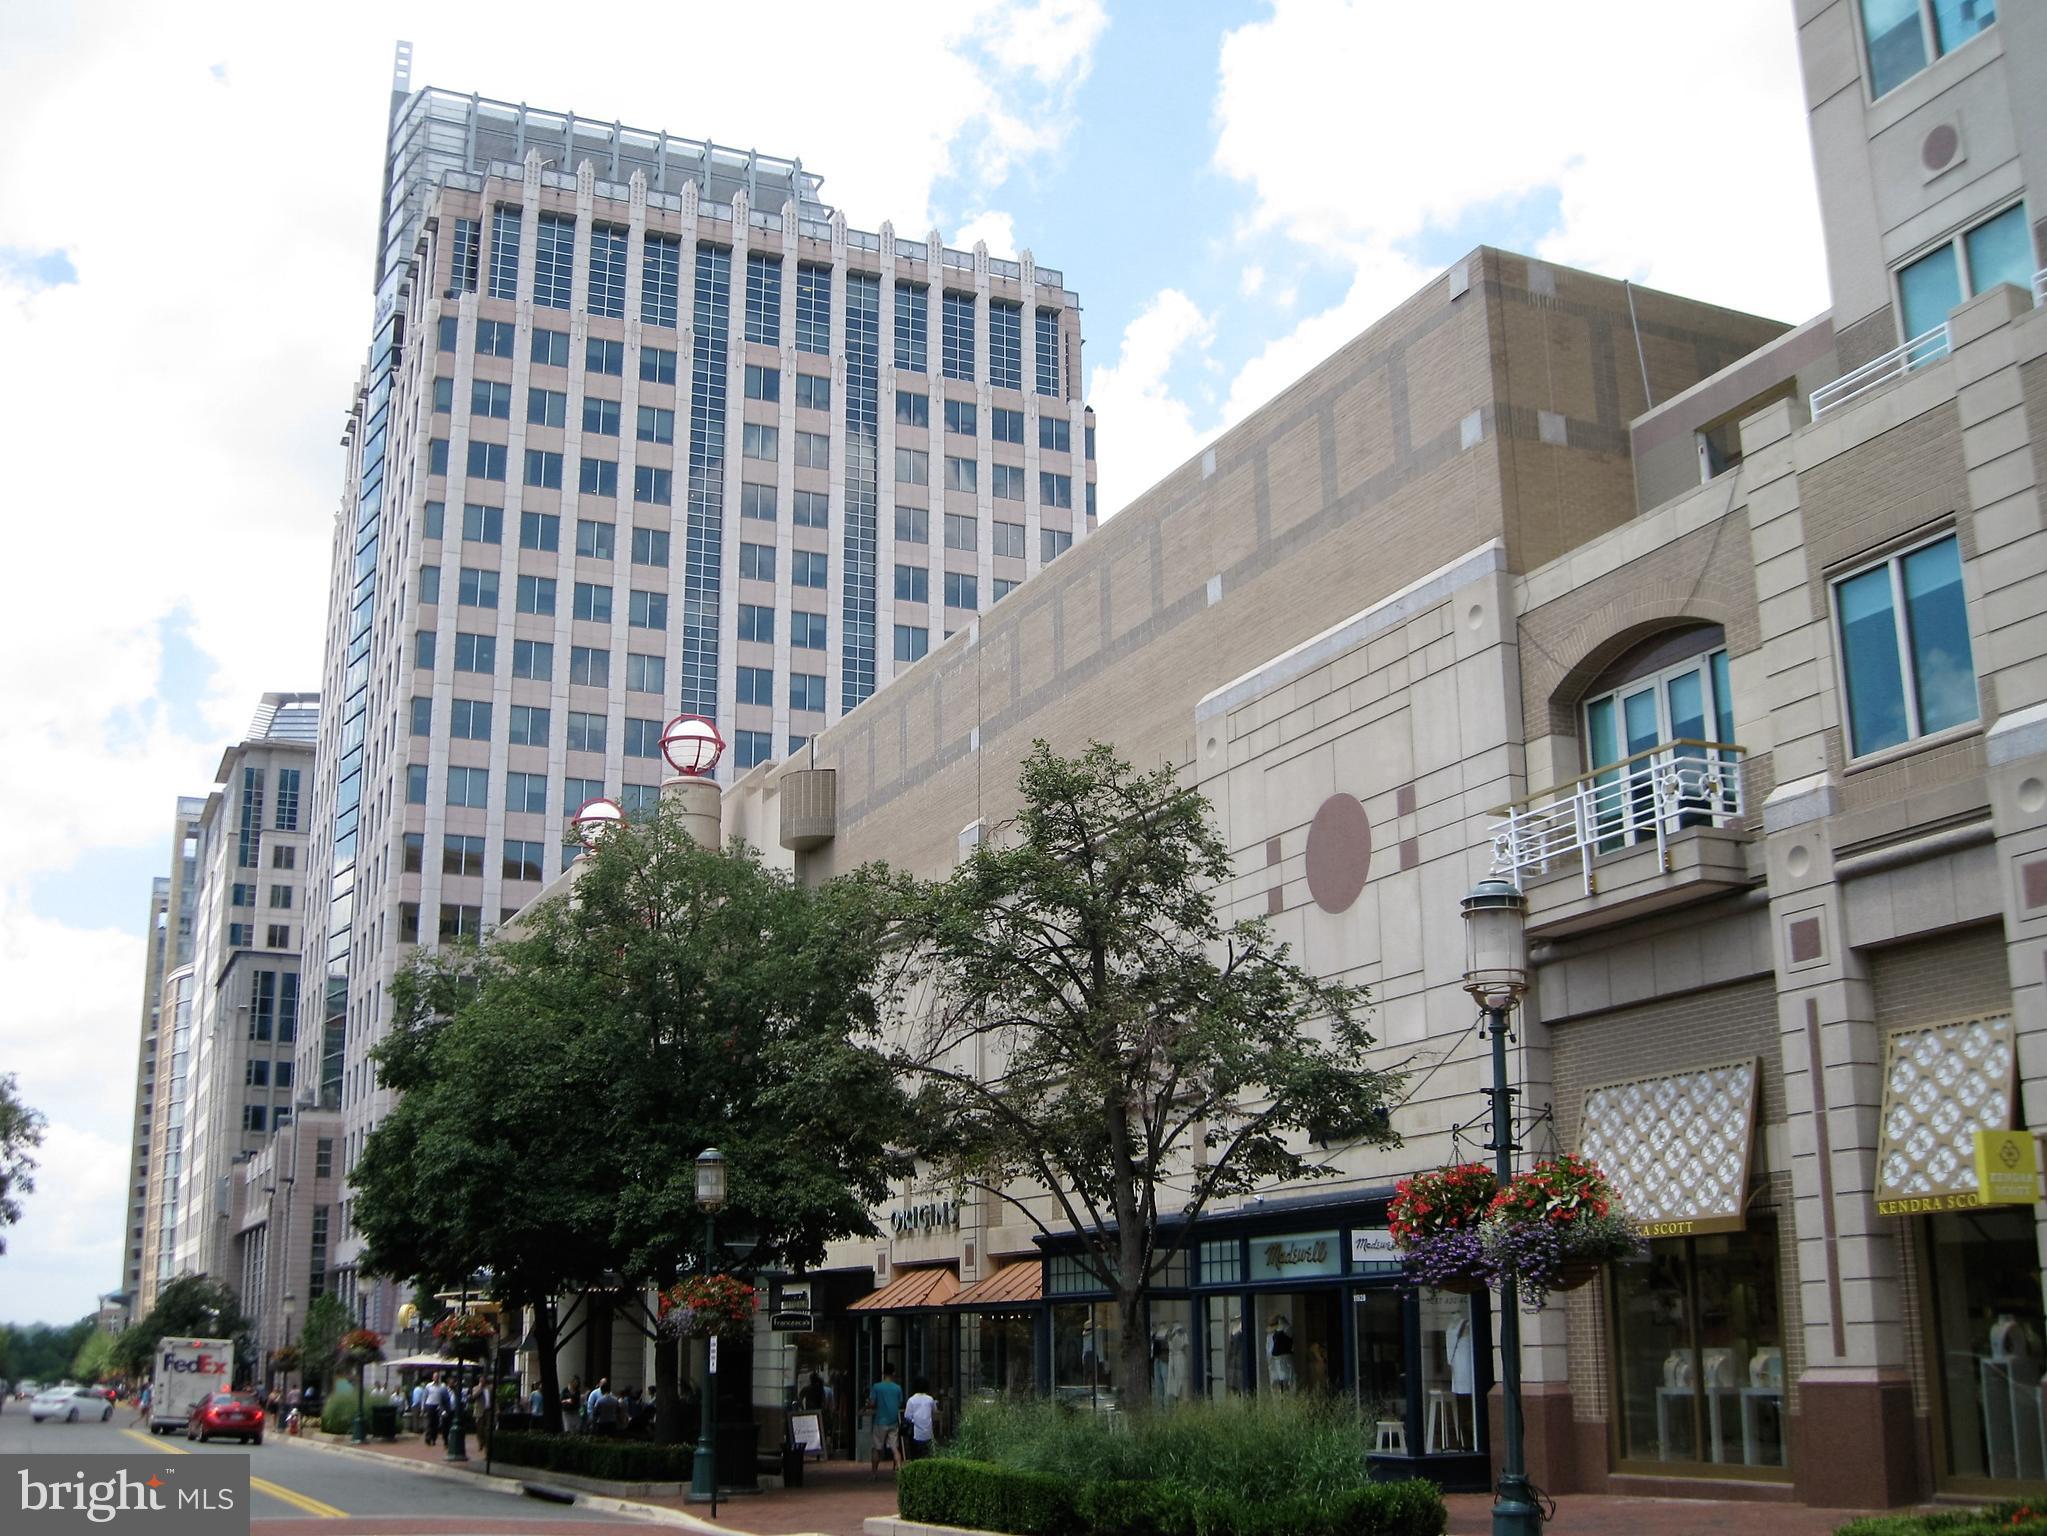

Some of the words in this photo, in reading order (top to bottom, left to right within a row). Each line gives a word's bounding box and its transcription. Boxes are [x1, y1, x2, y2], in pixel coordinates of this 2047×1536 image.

[1879, 1198, 1943, 1214] KENDRA
[1948, 1193, 1984, 1207] SCO
[890, 1200, 959, 1231] ORIGINS
[1653, 1221, 1693, 1235] SCOTT
[1265, 1240, 1327, 1271] Madewell
[164, 1353, 226, 1374] FedEx
